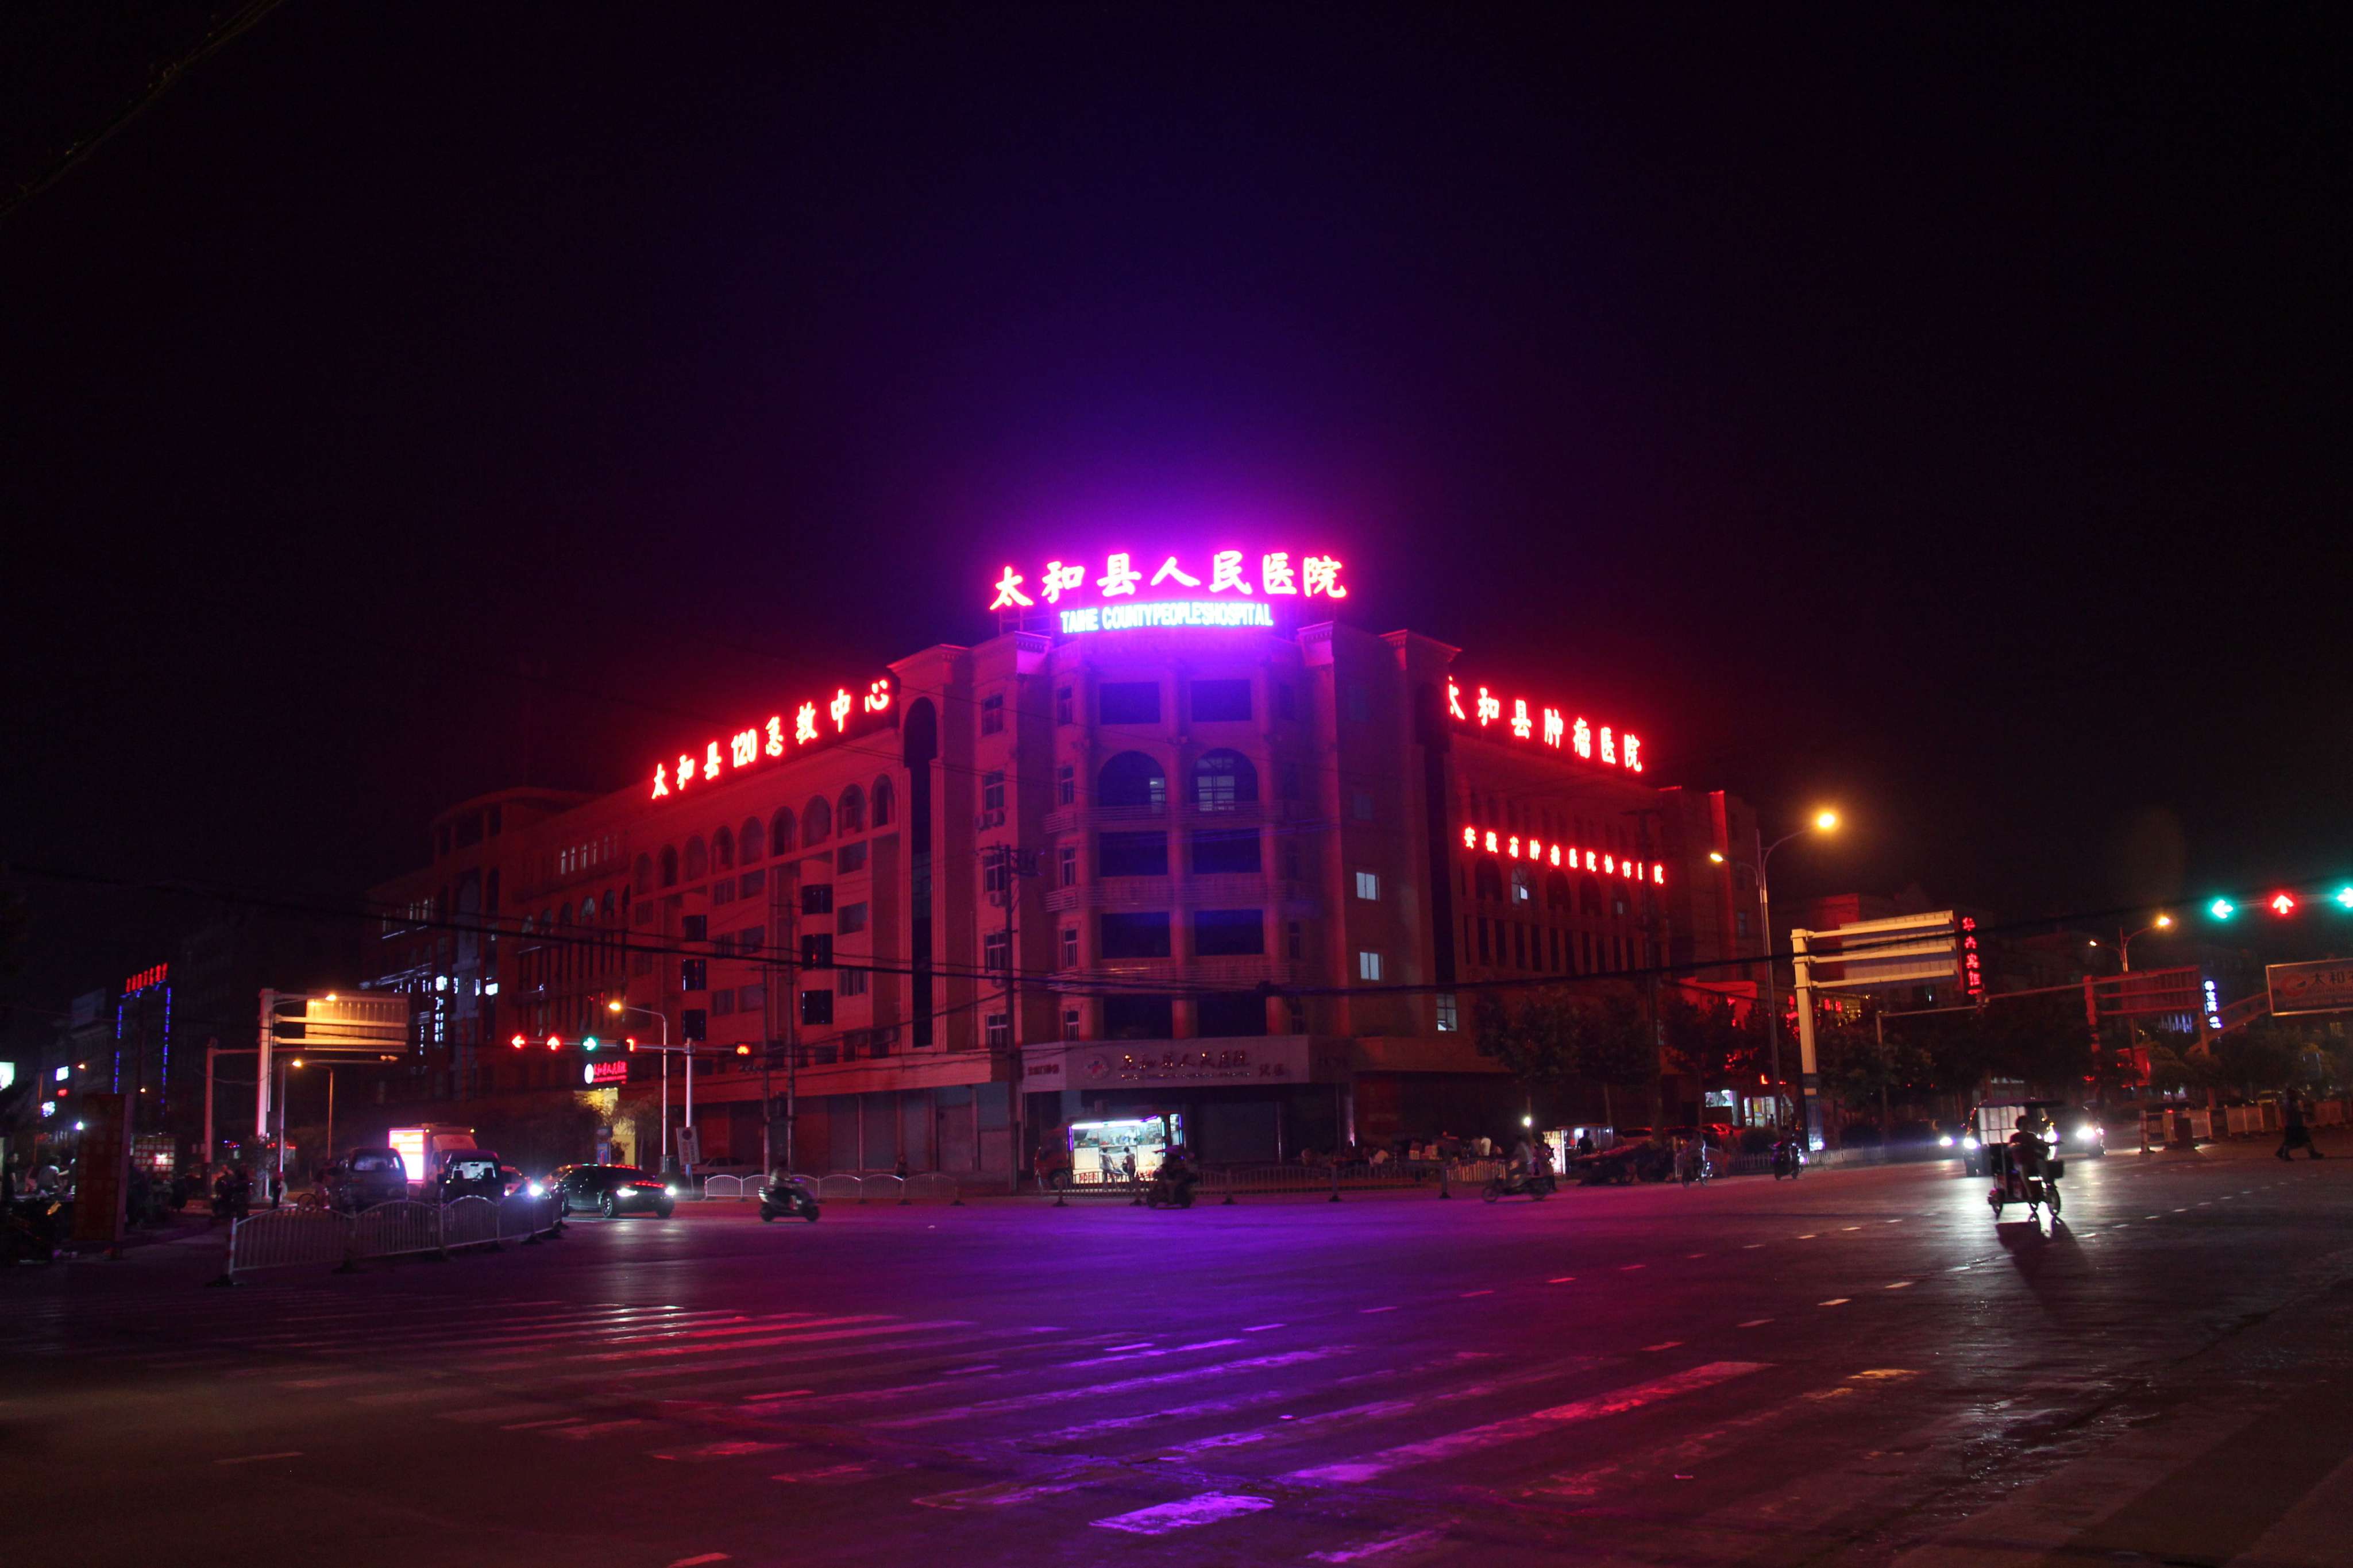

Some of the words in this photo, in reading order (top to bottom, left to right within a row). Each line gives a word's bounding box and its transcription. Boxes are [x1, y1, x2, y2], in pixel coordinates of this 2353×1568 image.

[989, 550, 1347, 610] 太和县人民医院
[651, 679, 889, 800] 太和县120急救中心
[1448, 675, 1642, 772] 太和县肿瘤医院
